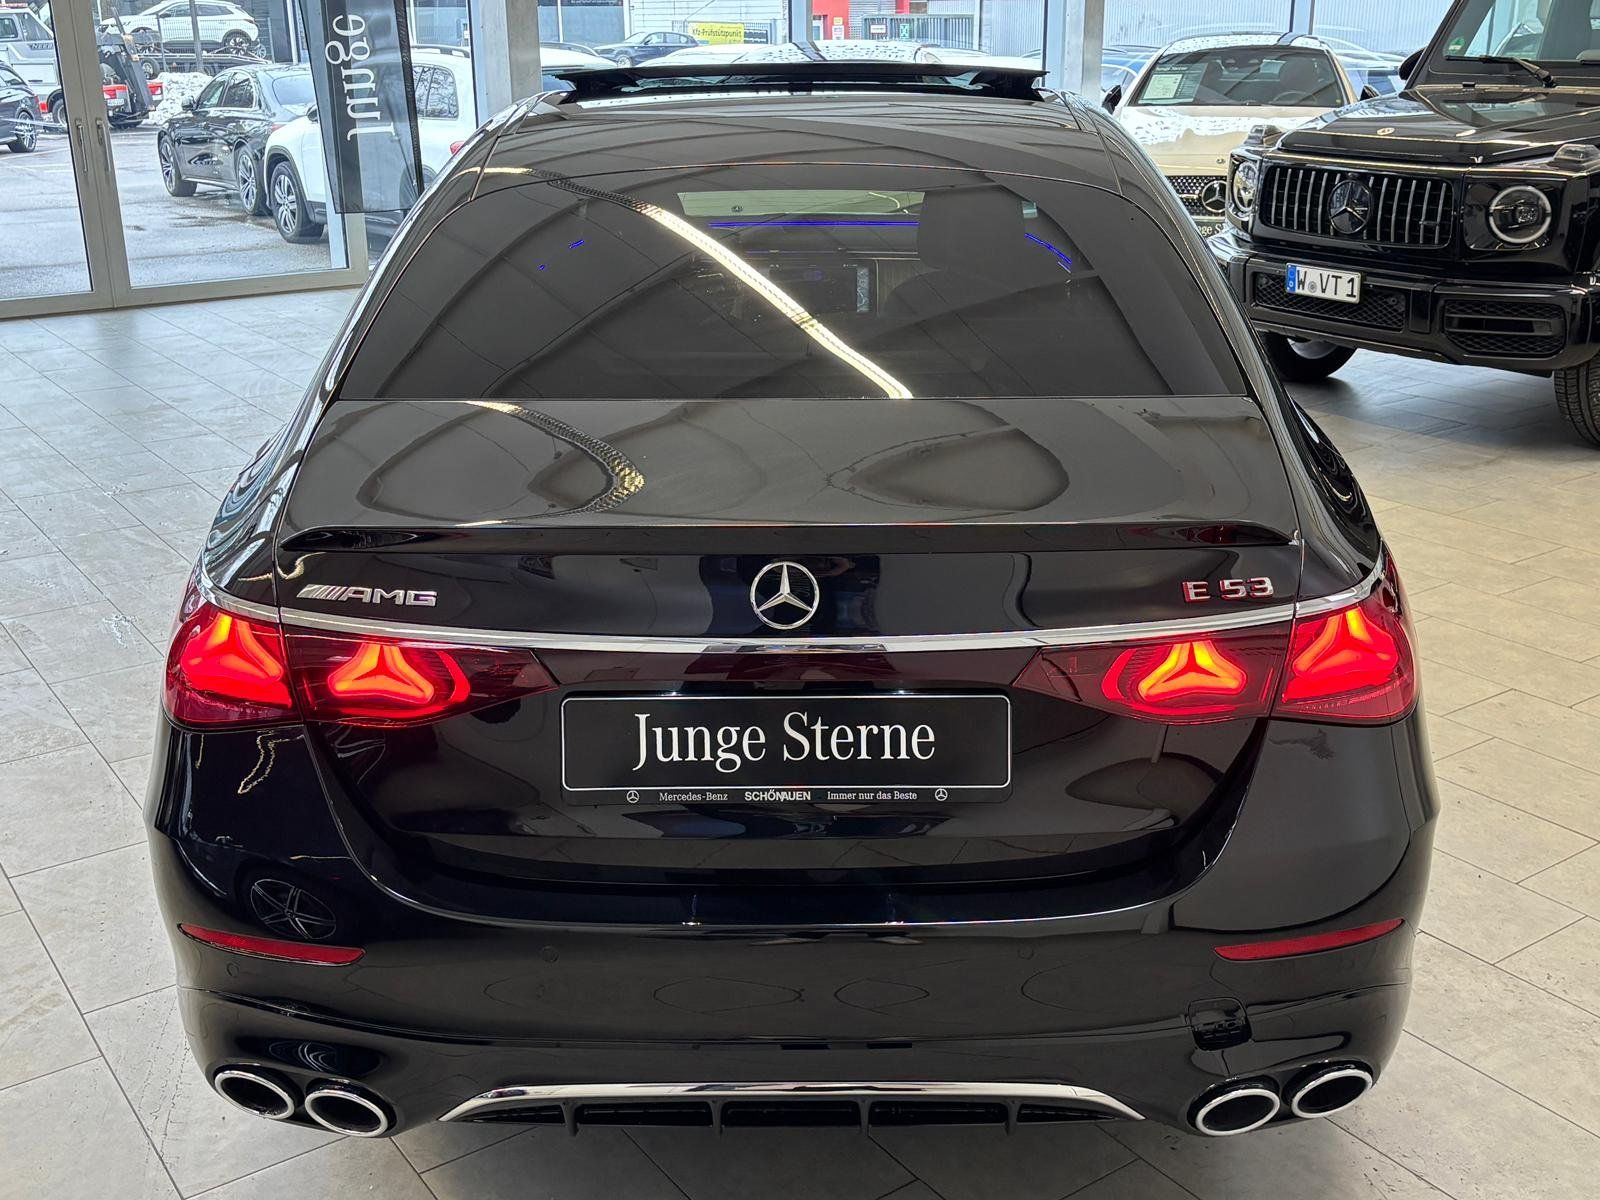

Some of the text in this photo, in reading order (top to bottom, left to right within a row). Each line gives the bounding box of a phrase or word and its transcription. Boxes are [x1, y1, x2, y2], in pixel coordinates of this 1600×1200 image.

[325, 14, 397, 141] Junge
[1297, 269, 1307, 290] W
[1319, 272, 1342, 296] VT
[1346, 276, 1357, 298] 1
[296, 583, 438, 607] AMG
[1182, 576, 1275, 603] E 53
[633, 711, 935, 773] Junge Sterne
[658, 791, 729, 802] Mercedes-Benz
[744, 789, 812, 802] SCHÖNAUEN
[826, 790, 918, 801] Immer nur das Beste
